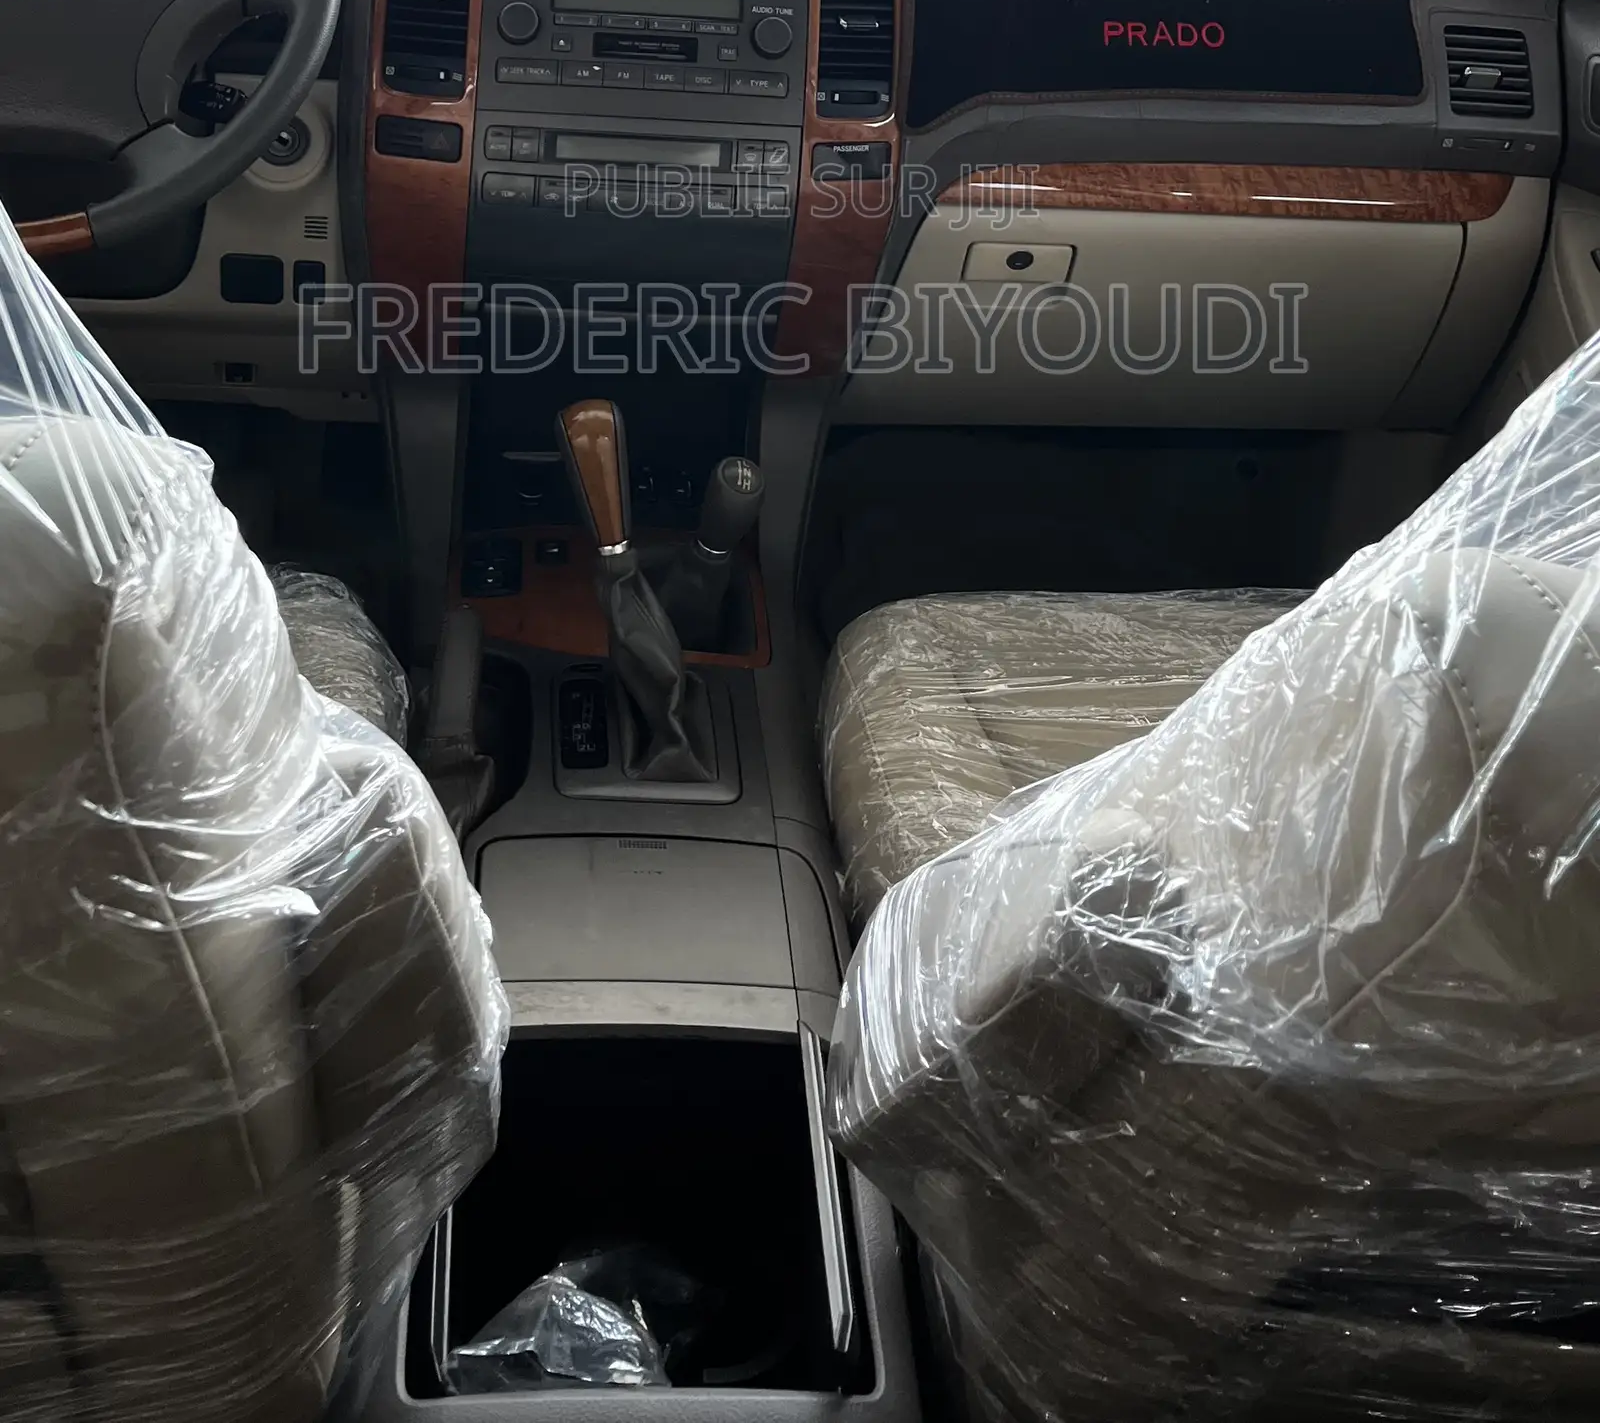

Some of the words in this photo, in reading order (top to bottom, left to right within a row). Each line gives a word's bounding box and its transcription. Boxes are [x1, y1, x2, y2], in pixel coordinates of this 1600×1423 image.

[751, 6, 774, 15] AUDIO
[775, 7, 795, 16] TUNE
[1103, 21, 1226, 48] PRADO
[577, 69, 591, 77] AM
[654, 73, 675, 82] TAPE
[694, 76, 713, 85] DISC
[749, 79, 770, 88] TYPE
[832, 144, 871, 153] PASSENGER
